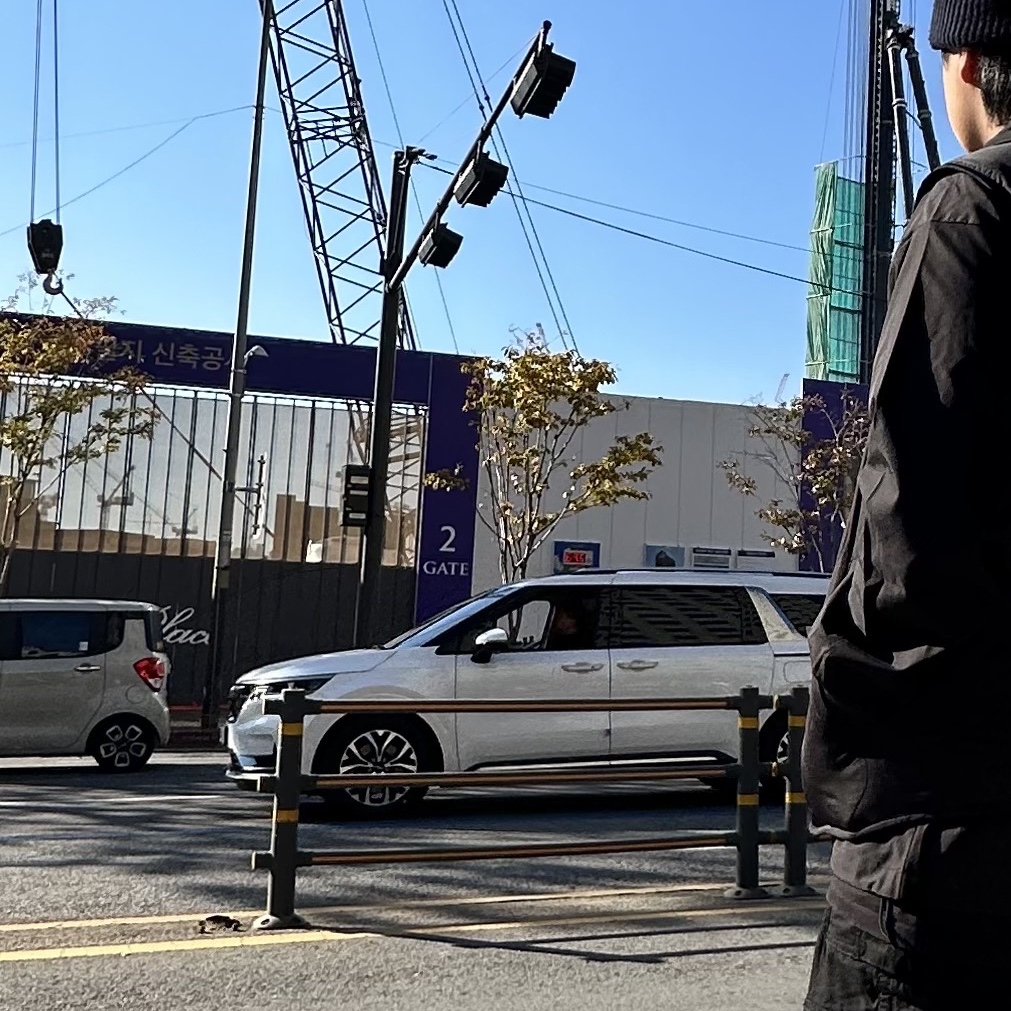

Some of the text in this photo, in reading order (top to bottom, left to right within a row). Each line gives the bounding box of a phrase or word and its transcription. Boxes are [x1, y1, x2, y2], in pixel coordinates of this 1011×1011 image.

[152, 341, 231, 371] 신축공
[439, 525, 456, 553] 2
[422, 560, 470, 577] GATE
